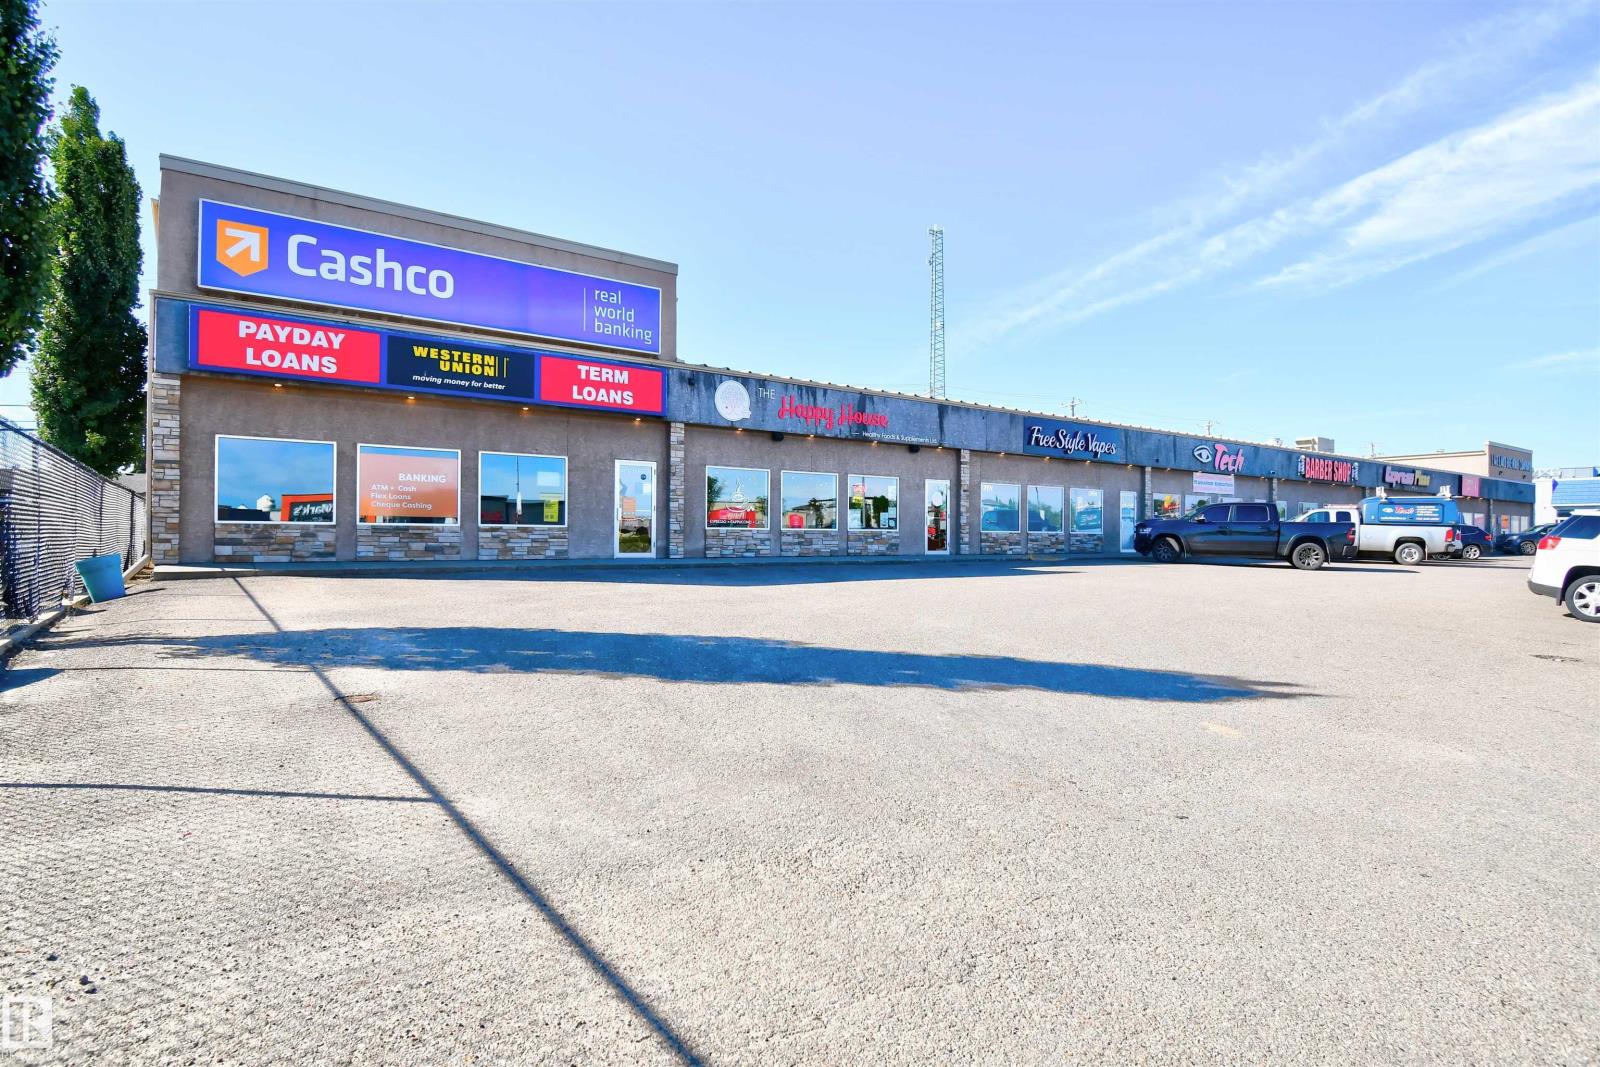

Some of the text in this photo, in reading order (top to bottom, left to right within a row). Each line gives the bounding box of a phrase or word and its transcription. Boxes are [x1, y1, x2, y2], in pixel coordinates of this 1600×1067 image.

[287, 234, 455, 299] Cashco
[594, 289, 622, 305] real
[594, 305, 635, 323] world
[238, 320, 345, 350] PAYDAY
[594, 319, 652, 345] banking
[246, 347, 338, 374] LOANS
[412, 345, 495, 366] WESTERN
[439, 360, 495, 377] UNION
[577, 364, 629, 385] TERM
[412, 374, 506, 390] moving money for better
[572, 385, 634, 406] LOANS
[758, 387, 776, 401] THE
[778, 394, 889, 430] Happy House
[1087, 433, 1117, 459] Vapes
[1214, 443, 1245, 473] Tech
[398, 472, 447, 484] BANKING
[1305, 457, 1352, 483] BARBER SHOP
[370, 483, 389, 491] ATM
[370, 501, 432, 510] Cheque Cashing
